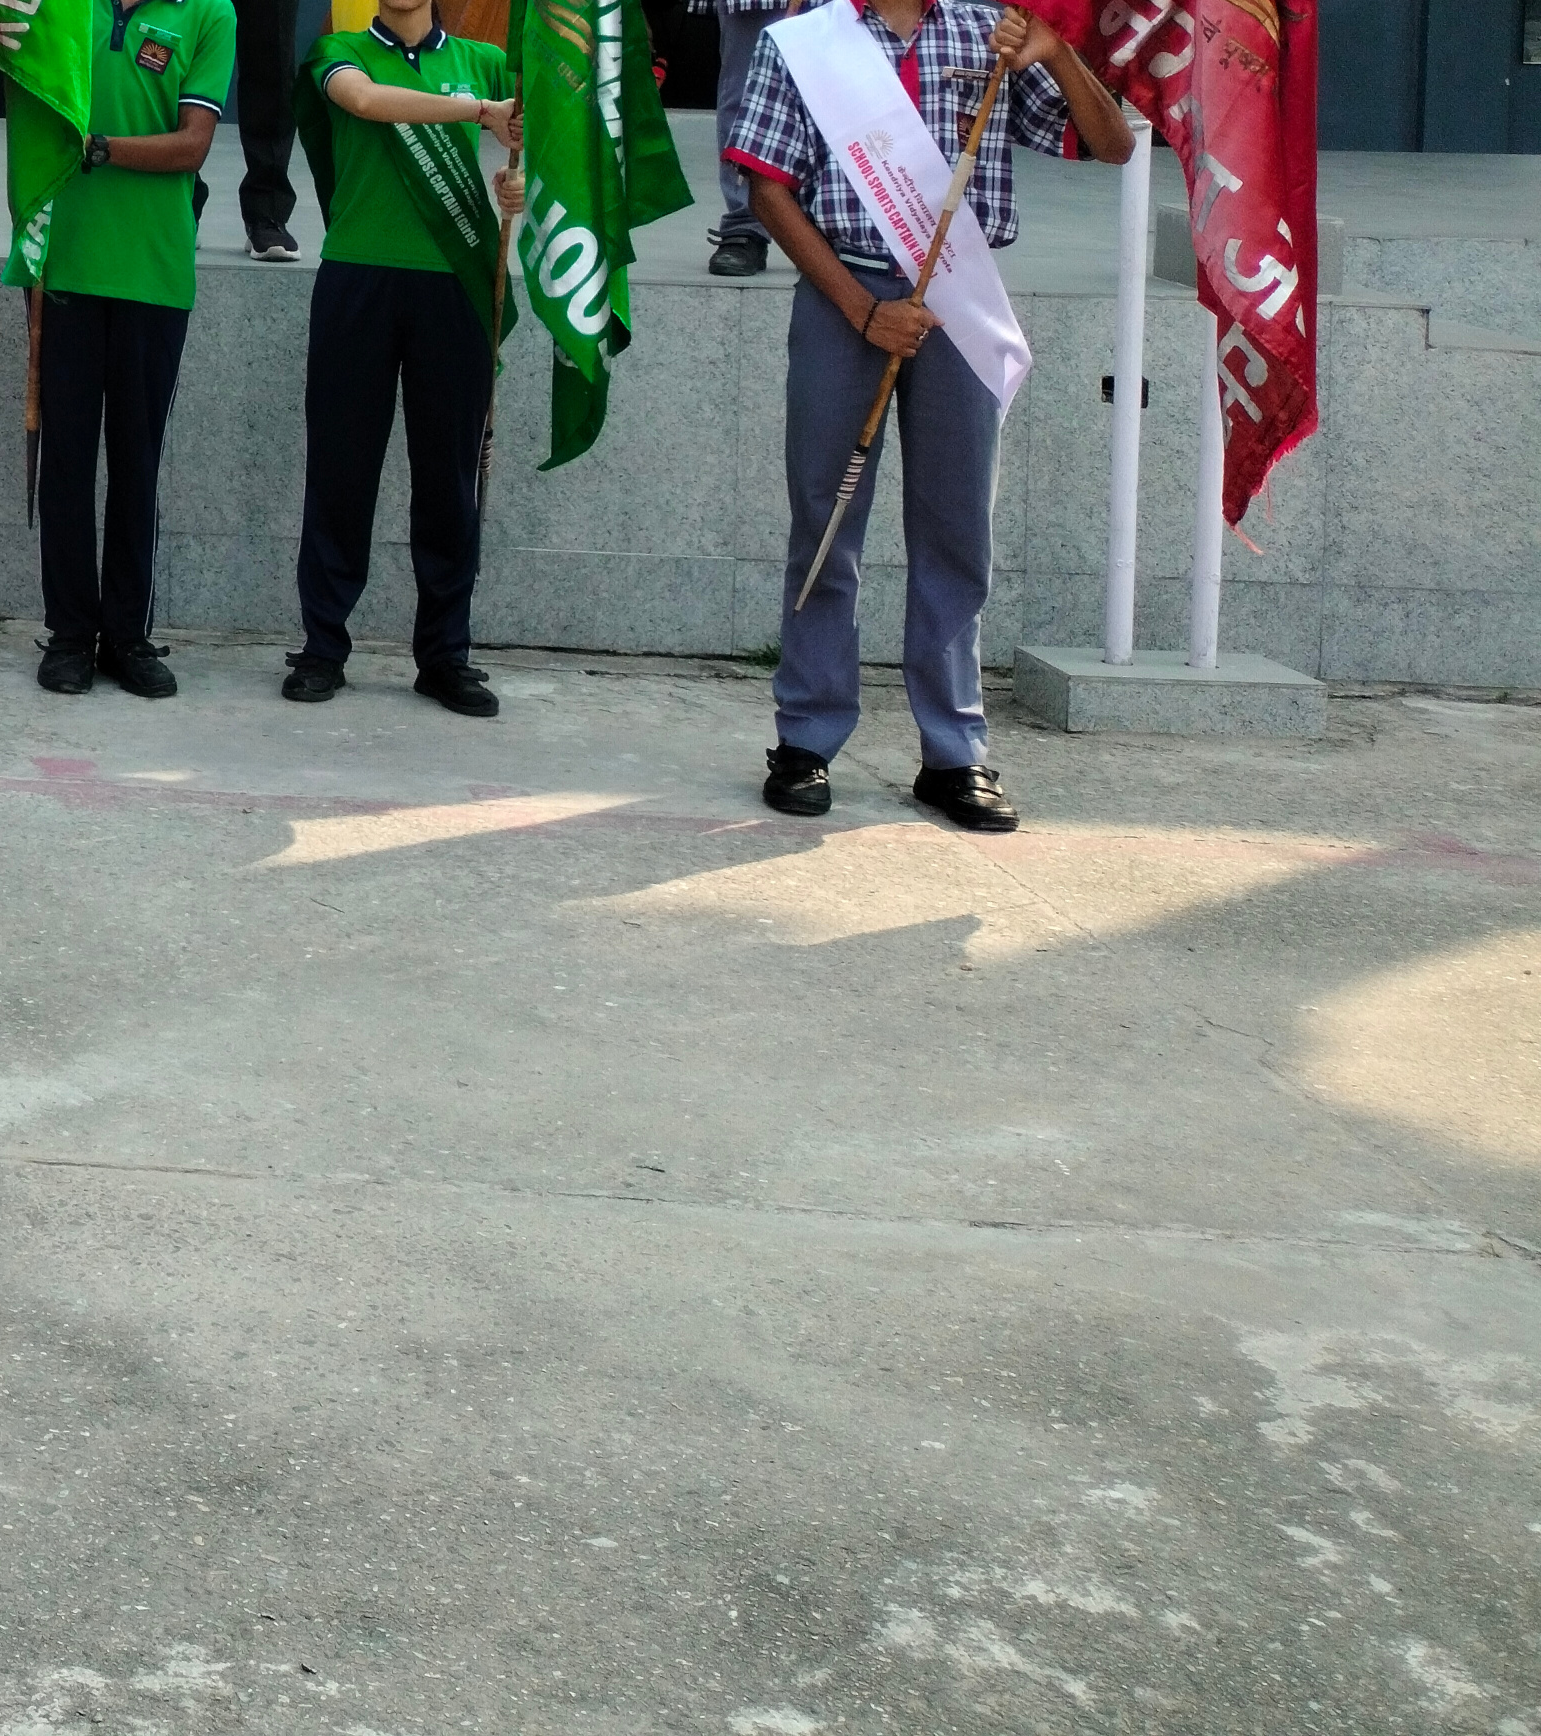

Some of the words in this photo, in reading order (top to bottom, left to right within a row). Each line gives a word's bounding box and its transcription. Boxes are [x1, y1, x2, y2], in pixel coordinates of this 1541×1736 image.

[409, 142, 439, 178] HOUSE
[430, 173, 462, 217] CAPTAIN
[454, 211, 480, 248] (Girls)
[441, 152, 465, 189] Vidyalaya
[848, 141, 876, 180] SCHOOL
[868, 176, 897, 215] SPORTS
[888, 210, 918, 252] CAPTAIN
[881, 160, 906, 198] Kendriya
[904, 197, 932, 240] Vidyalaya
